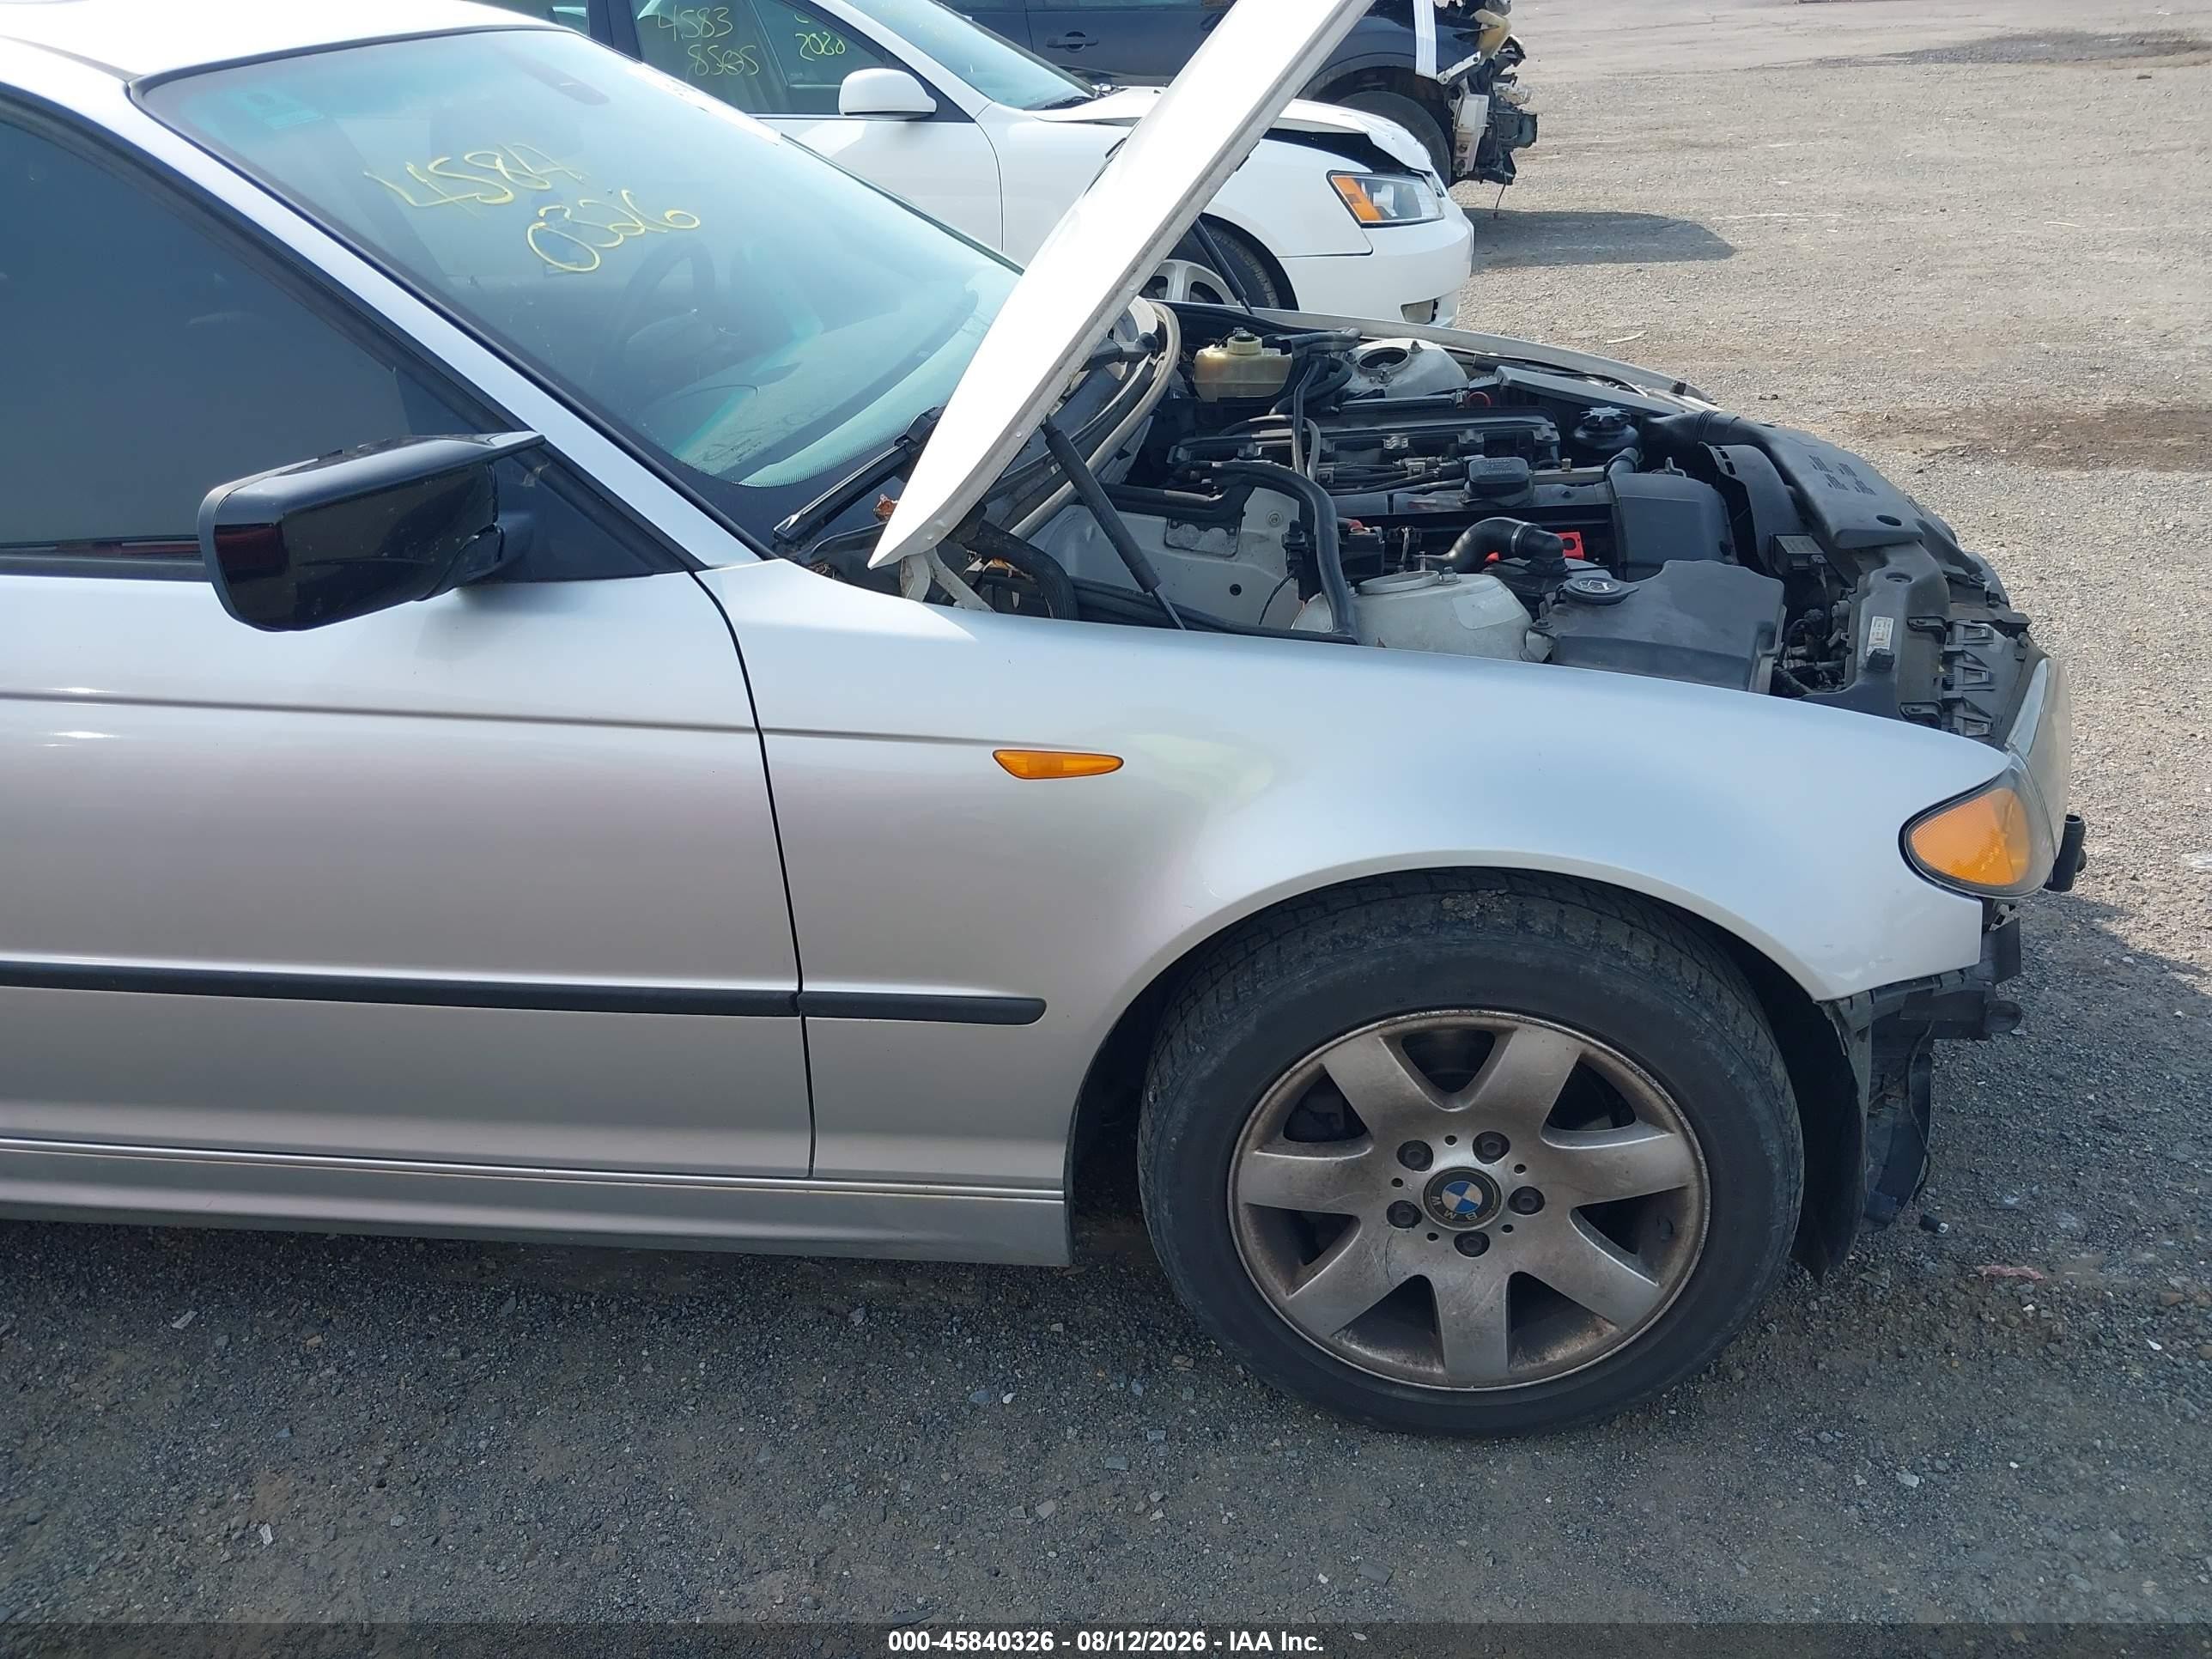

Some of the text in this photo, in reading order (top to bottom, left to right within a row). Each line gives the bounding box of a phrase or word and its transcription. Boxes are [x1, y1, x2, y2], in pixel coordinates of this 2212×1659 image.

[364, 143, 587, 216] 4584
[527, 189, 701, 272] 0326
[1431, 1195, 1478, 1221] BMW
